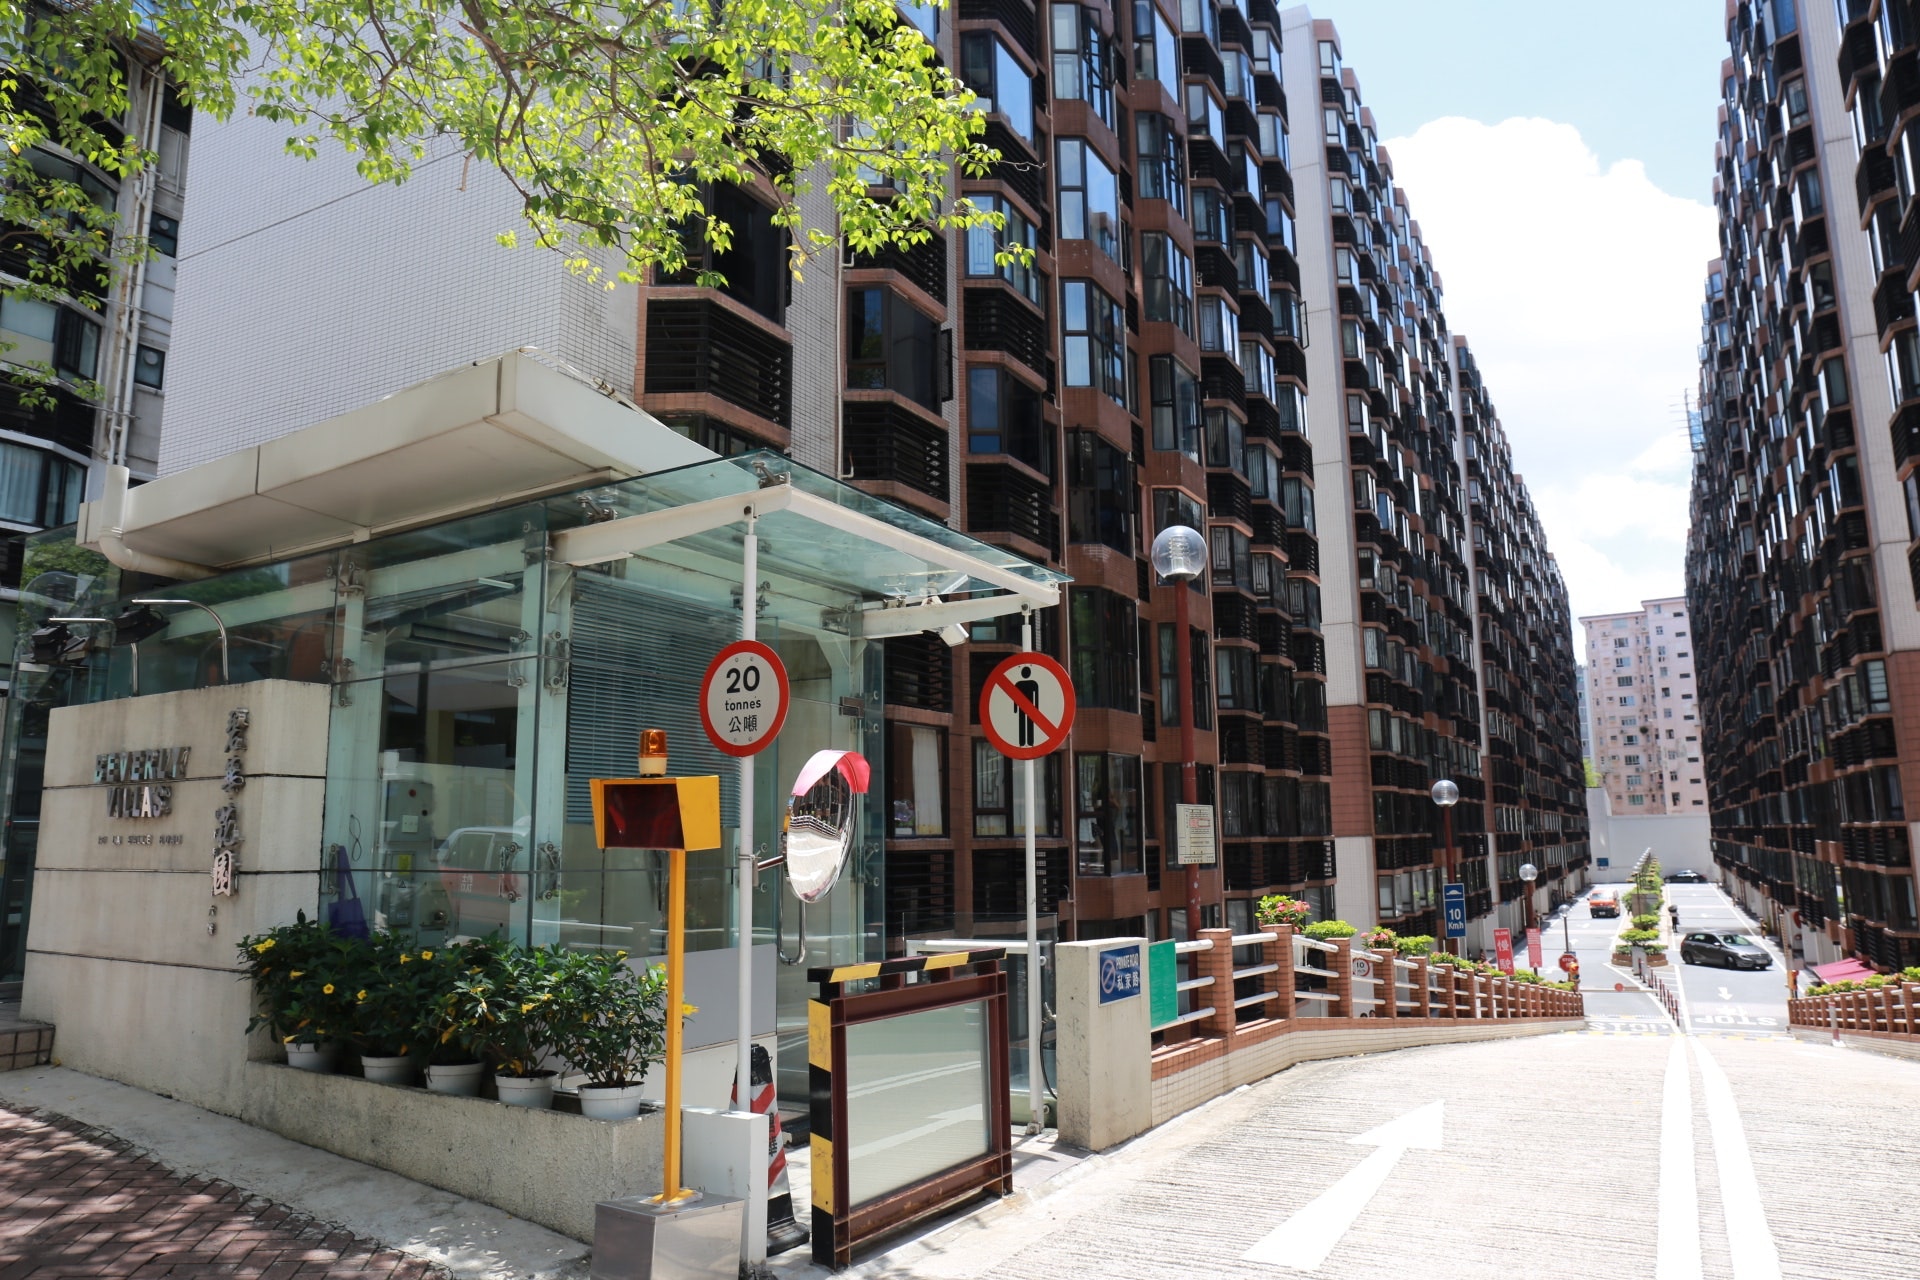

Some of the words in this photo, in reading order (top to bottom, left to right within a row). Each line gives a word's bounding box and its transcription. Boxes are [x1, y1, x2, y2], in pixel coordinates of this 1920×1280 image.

[726, 665, 760, 694] 20
[725, 699, 761, 711] tonnes
[728, 714, 758, 733] 公噸
[93, 746, 191, 784] BEVERLY
[107, 784, 172, 818] VILLAS
[1448, 908, 1461, 921] 10
[1117, 971, 1139, 990] 私家路
[1695, 1015, 1778, 1026] STOP
